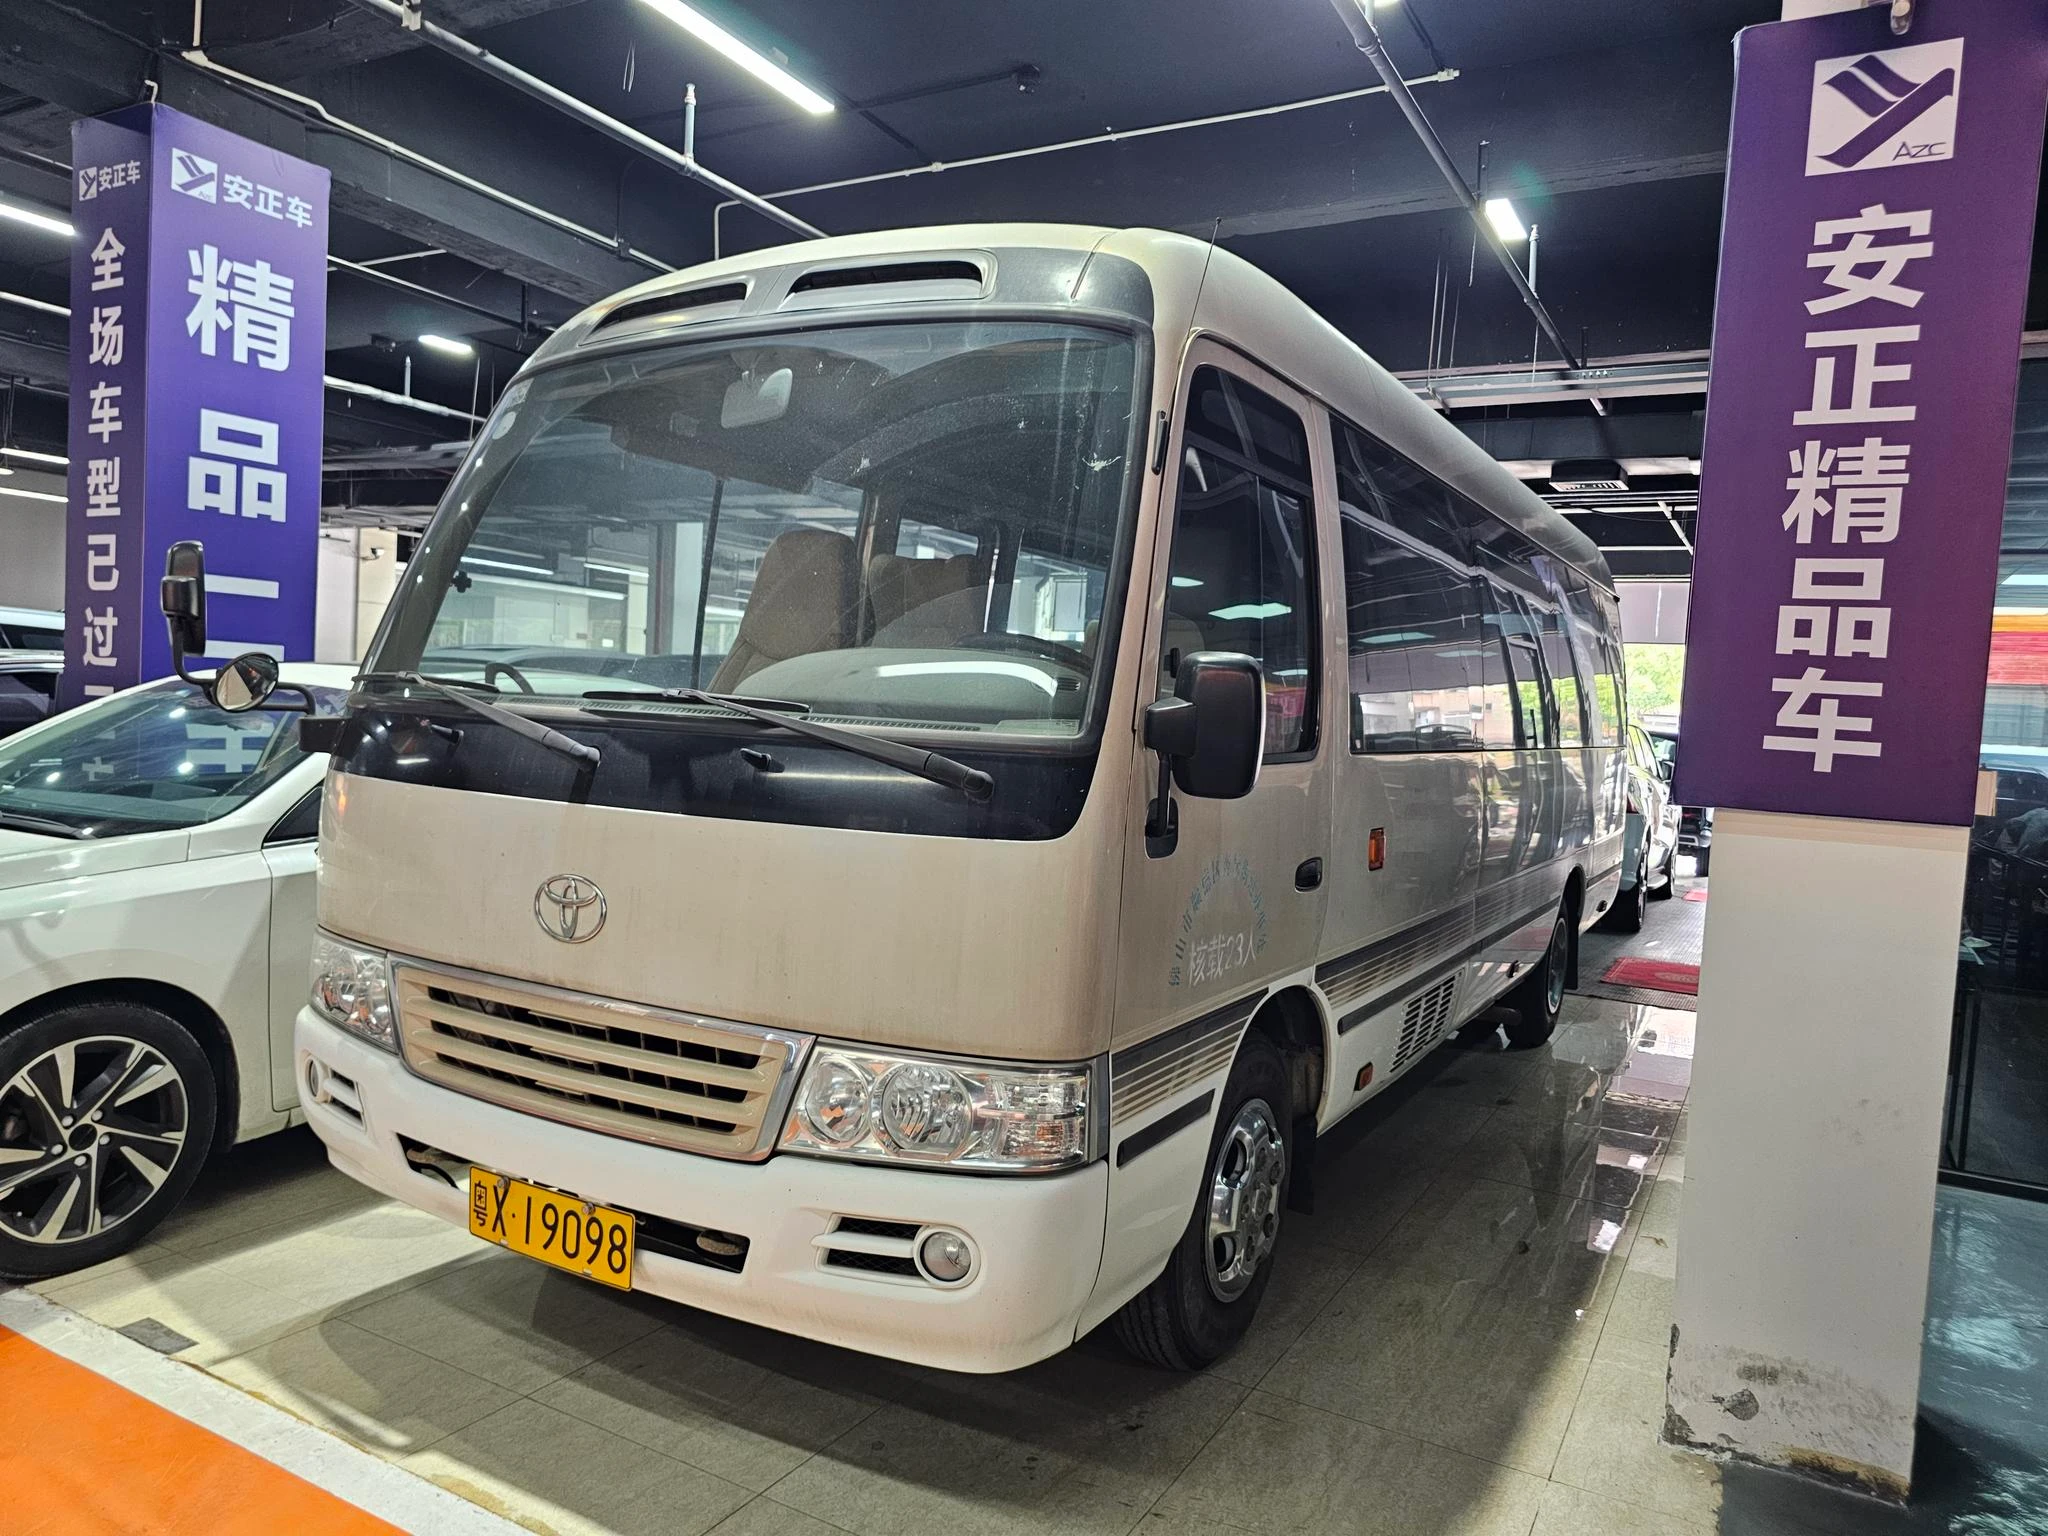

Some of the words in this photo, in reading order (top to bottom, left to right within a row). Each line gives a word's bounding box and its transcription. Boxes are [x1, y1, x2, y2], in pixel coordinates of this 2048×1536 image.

[99, 160, 140, 191] 安正车
[1892, 141, 1947, 161] AZC
[223, 173, 313, 228] 安正车
[1763, 203, 1934, 773] 安正精品车
[1188, 926, 1256, 987] 核载23人
